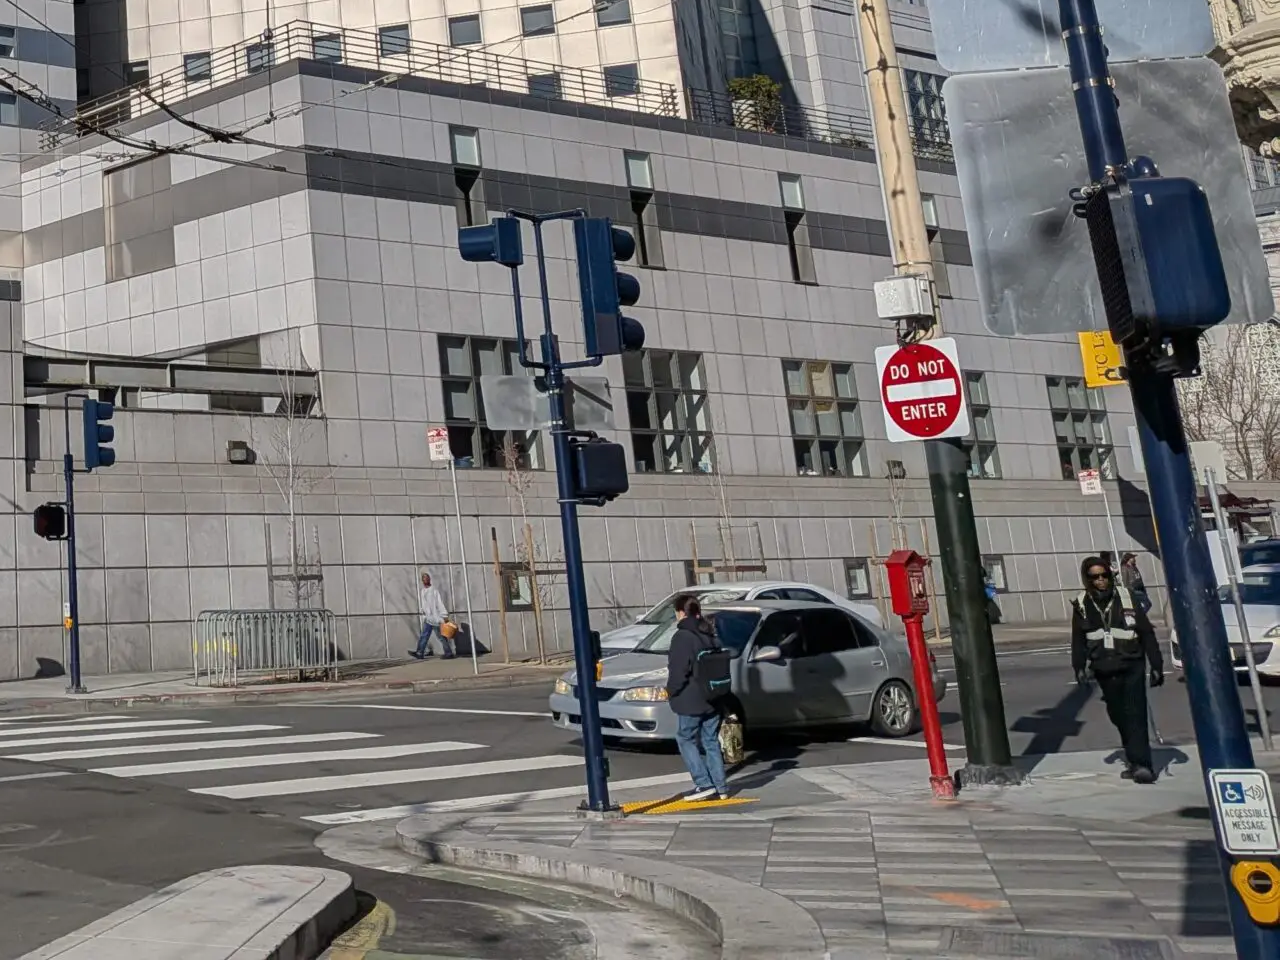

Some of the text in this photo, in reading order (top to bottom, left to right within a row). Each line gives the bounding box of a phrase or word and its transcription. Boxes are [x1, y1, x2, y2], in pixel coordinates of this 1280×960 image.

[890, 359, 945, 380] DO NOT
[901, 402, 948, 421] ENTER
[1224, 808, 1269, 819] ACCESSIBLE
[1232, 820, 1266, 830] MESSAGE
[1240, 832, 1261, 842] ONLY
